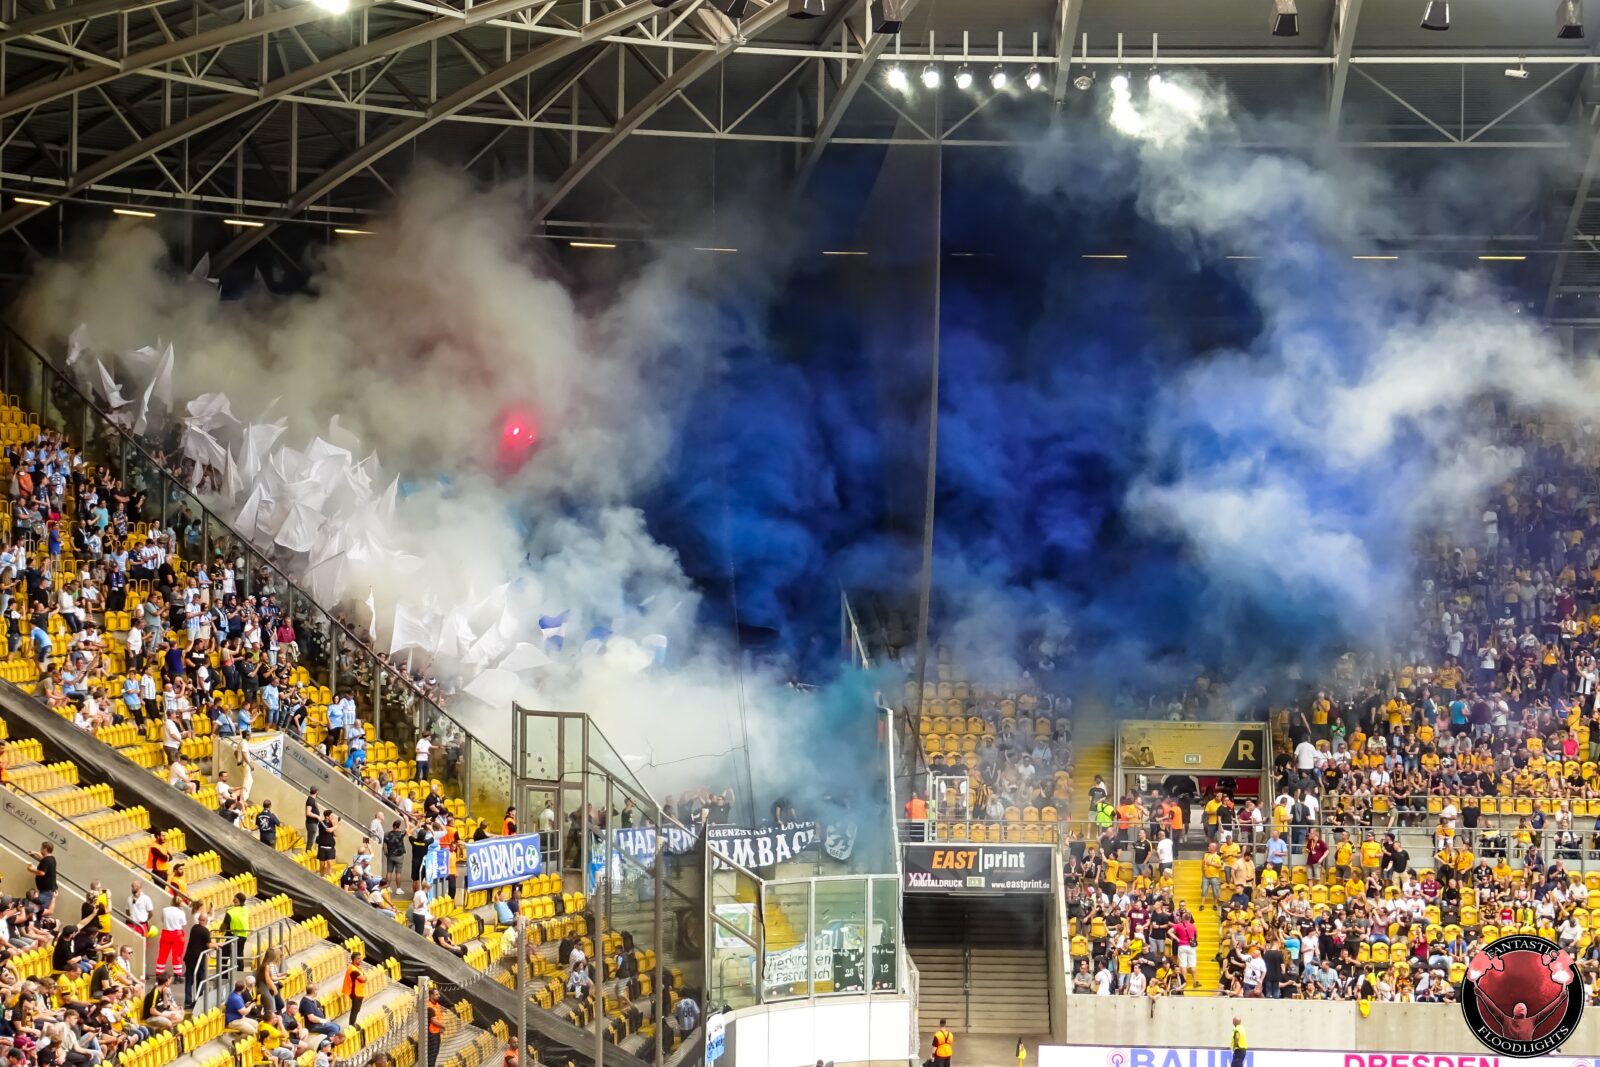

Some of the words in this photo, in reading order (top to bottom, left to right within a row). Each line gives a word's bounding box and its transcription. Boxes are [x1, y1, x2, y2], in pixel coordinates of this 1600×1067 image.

[1237, 739, 1255, 761] R
[931, 850, 977, 869] EAST
[983, 850, 1025, 870] print
[991, 879, 1050, 890] www.eastprint.de
